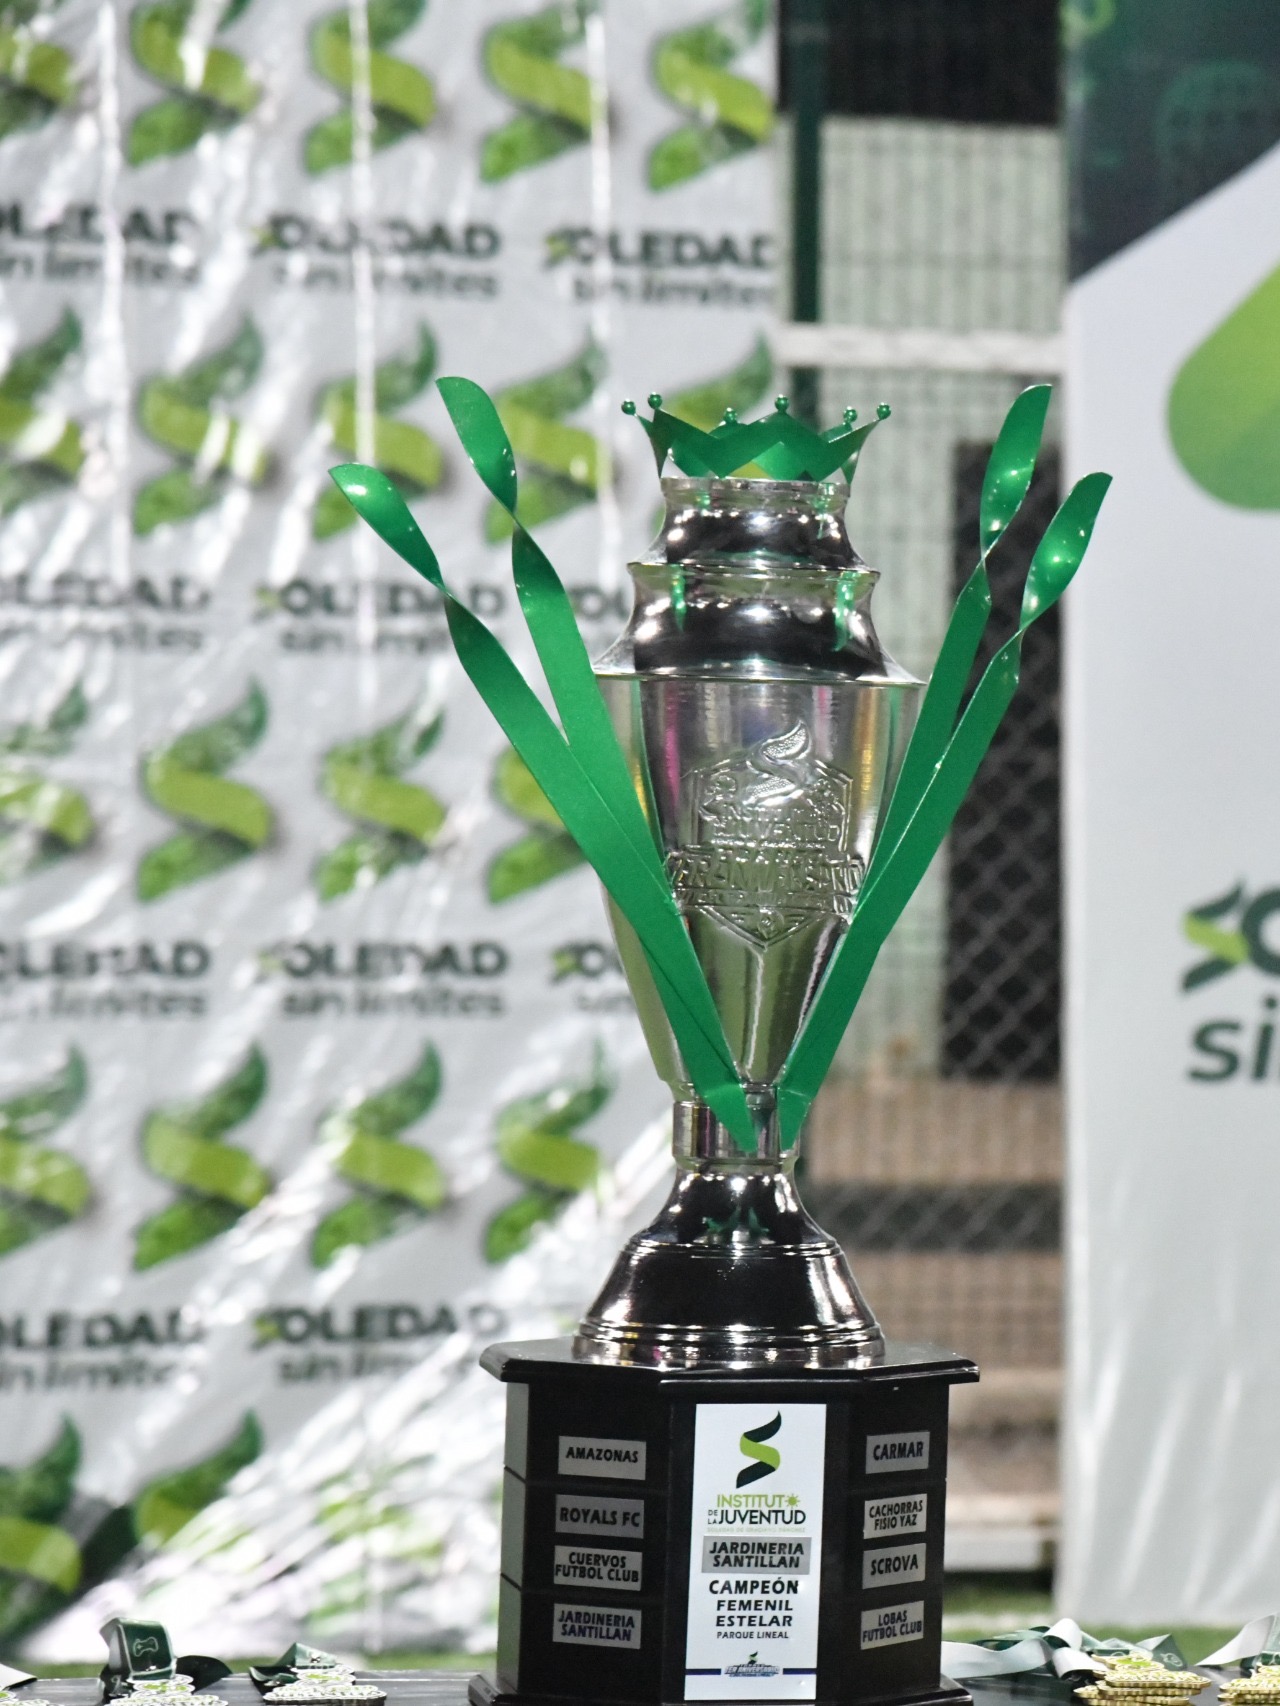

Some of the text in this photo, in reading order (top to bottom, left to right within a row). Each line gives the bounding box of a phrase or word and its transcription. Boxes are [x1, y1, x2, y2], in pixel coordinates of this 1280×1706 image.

[565, 1446, 639, 1464] AMAZONAS
[873, 1441, 924, 1461] CARMAR
[560, 1507, 641, 1528] ROYALS FC
[718, 1509, 806, 1525] JUVENTUD
[869, 1500, 923, 1519] CACHORRAS
[874, 1514, 918, 1531] FISIO YAZ
[709, 1541, 805, 1556] JARDINERIA
[568, 1551, 627, 1569] CUERVOS
[712, 1554, 800, 1569] SANTILLAN
[870, 1554, 919, 1576] SCROVA
[555, 1564, 640, 1583] FUTBOL CLUB
[709, 1576, 799, 1595] CAMPEÓN
[716, 1599, 794, 1612] FEMENIL
[558, 1610, 636, 1629] JARDINERIA
[715, 1615, 794, 1627] ESTELAR
[878, 1610, 908, 1627] LOBAS
[561, 1624, 632, 1642] SANTILLAN
[716, 1631, 790, 1639] PARQUE LINEAL
[862, 1620, 923, 1643] FUTBOL CLUB
